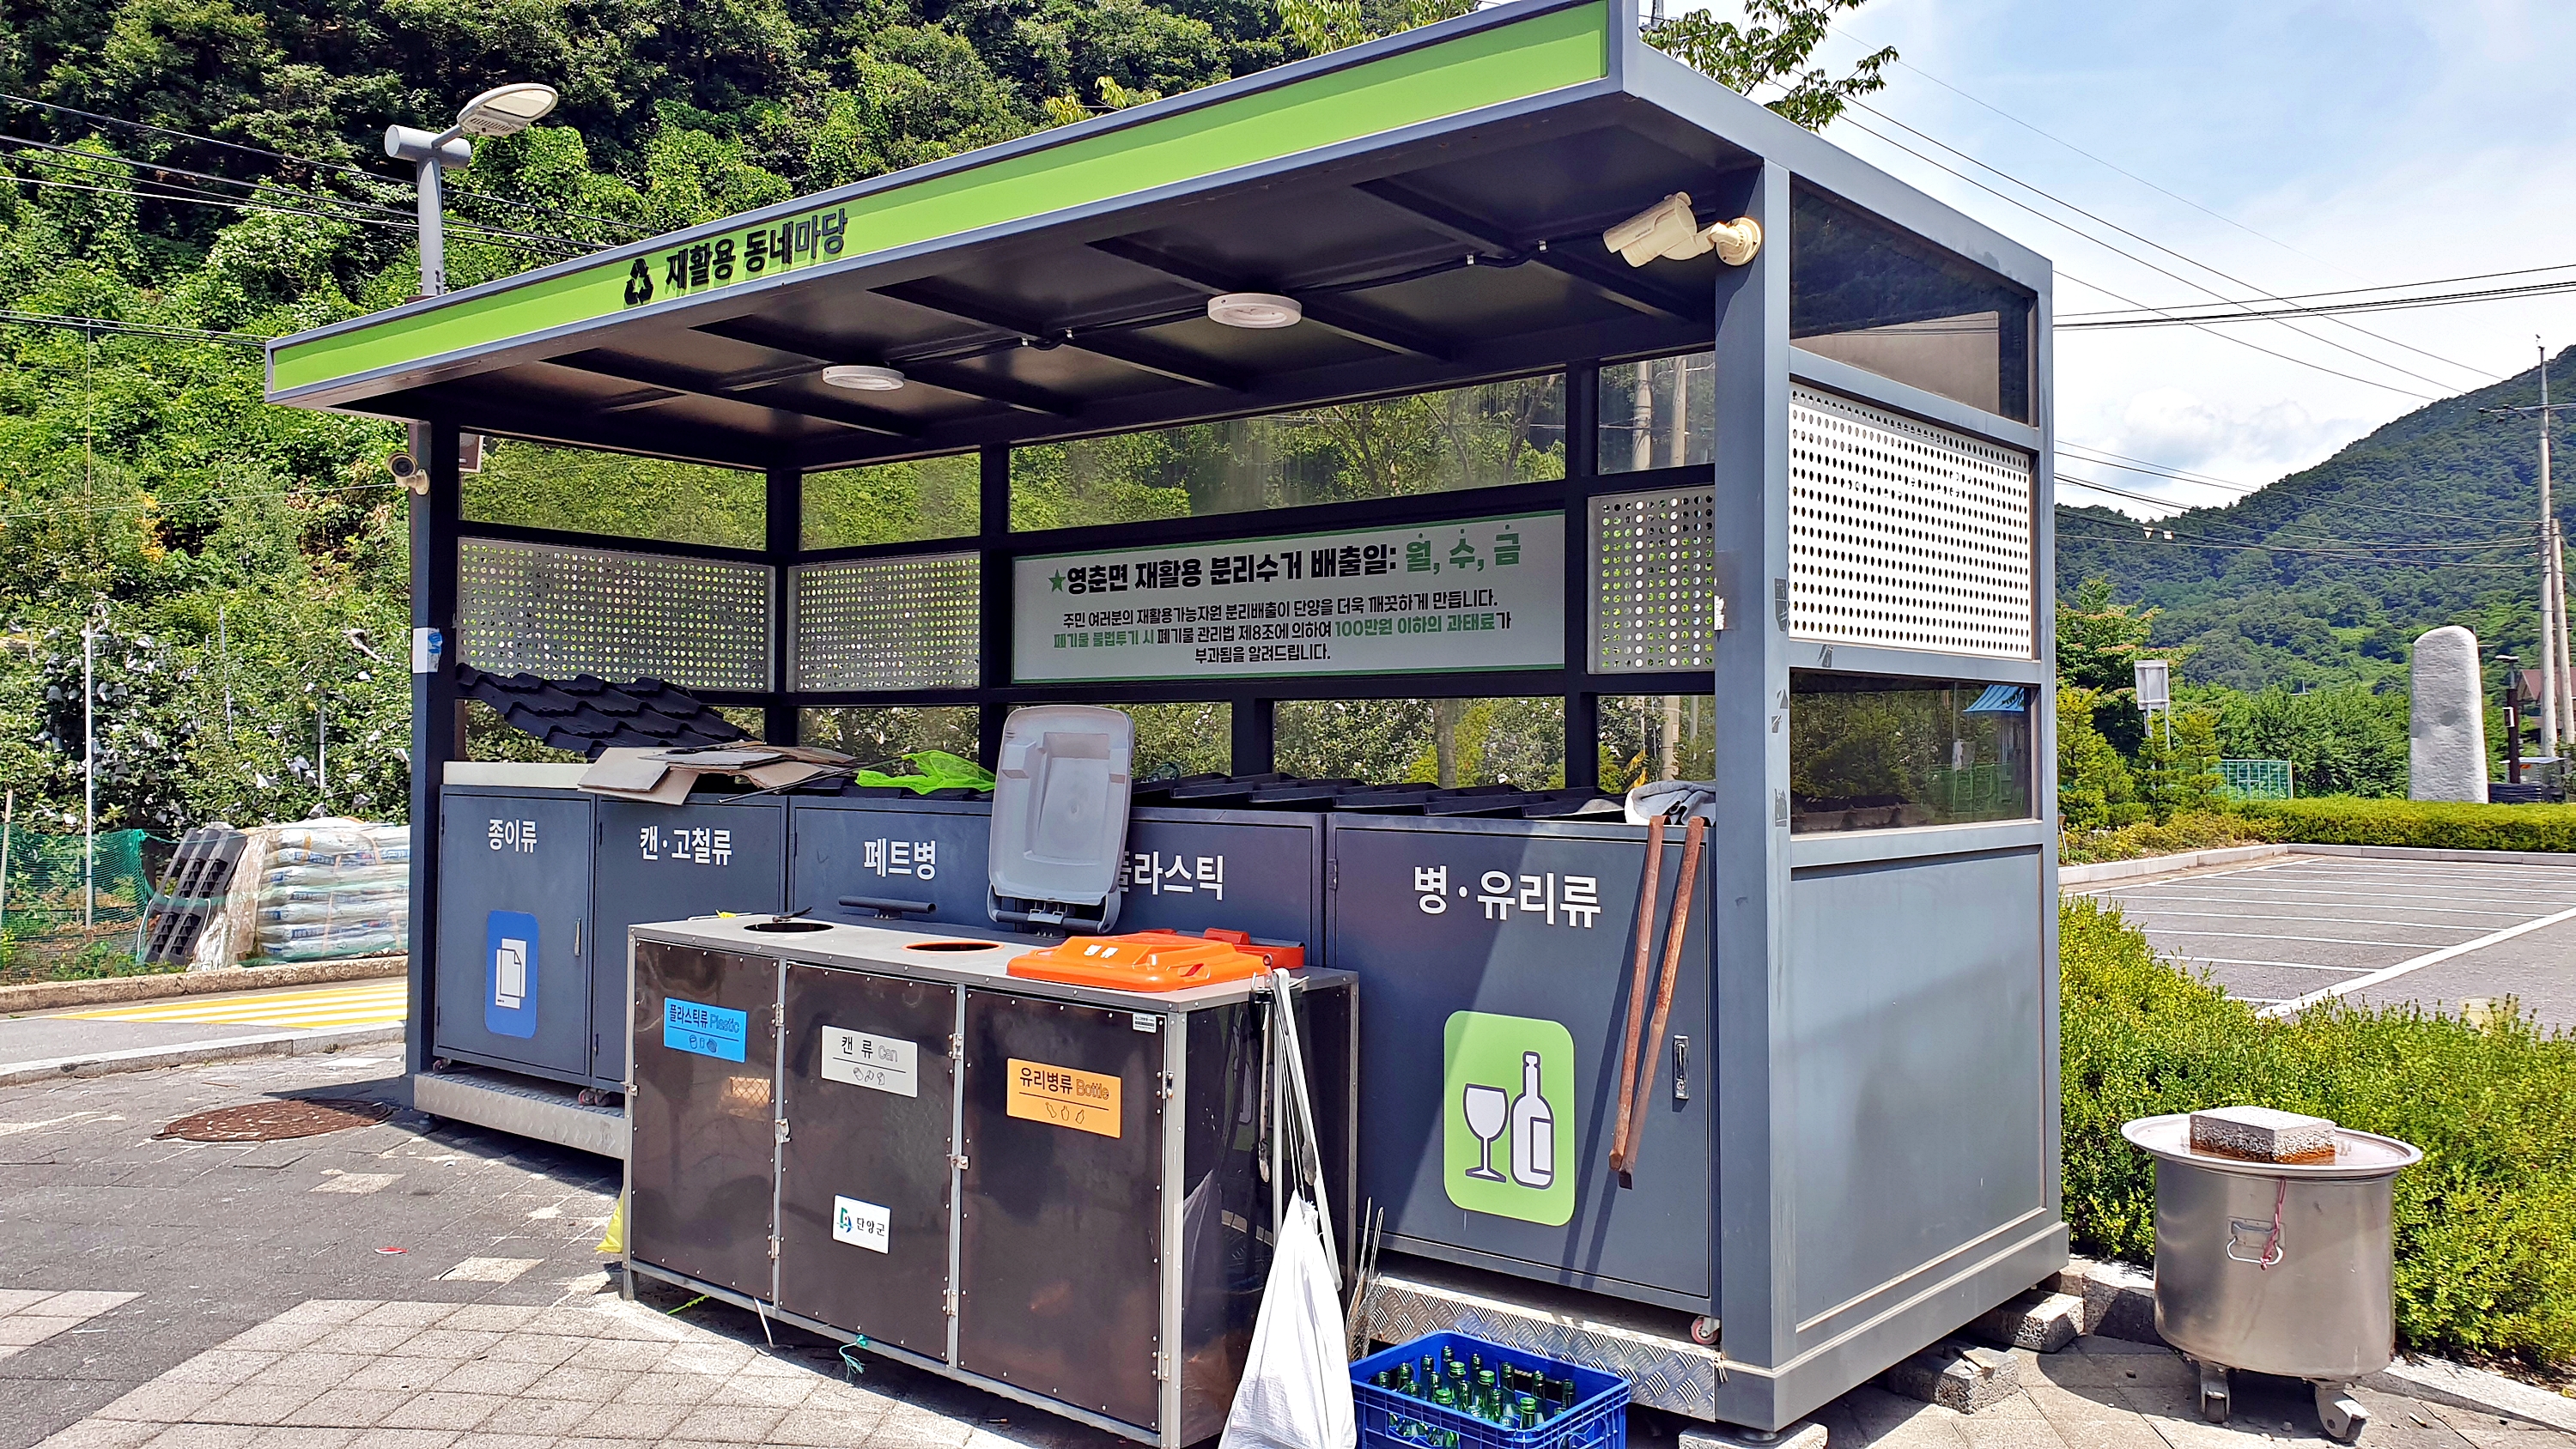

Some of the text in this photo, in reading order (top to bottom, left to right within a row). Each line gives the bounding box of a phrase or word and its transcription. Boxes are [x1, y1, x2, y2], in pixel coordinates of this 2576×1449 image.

[665, 208, 848, 289] 재활용 동네마당
[1066, 524, 1522, 595] 영춘면 재활용 분리수거 배출일: 월, 수, 금
[1062, 588, 1499, 629] 주민 여러분의 재활용가능자원 분리배출이 단양을 더욱 깨끗하게 만듭니다.
[1053, 611, 1512, 649] 폐기물 불법투기 시 폐기물 관리법 제8조에 의하여 100만원 이하의 과태료가
[1194, 643, 1332, 664] 부과됨을 알려드립니다.
[487, 817, 538, 853] 종이류
[639, 824, 733, 866] 캔·고철류
[863, 837, 937, 881] 페트병
[1413, 864, 1602, 929] 병·유리류
[669, 1003, 740, 1034] 플라스틱류 Plastic
[878, 1044, 898, 1063] Can
[1019, 1066, 1109, 1100] 유리병류 Bottle
[856, 1216, 885, 1237] 단양군
